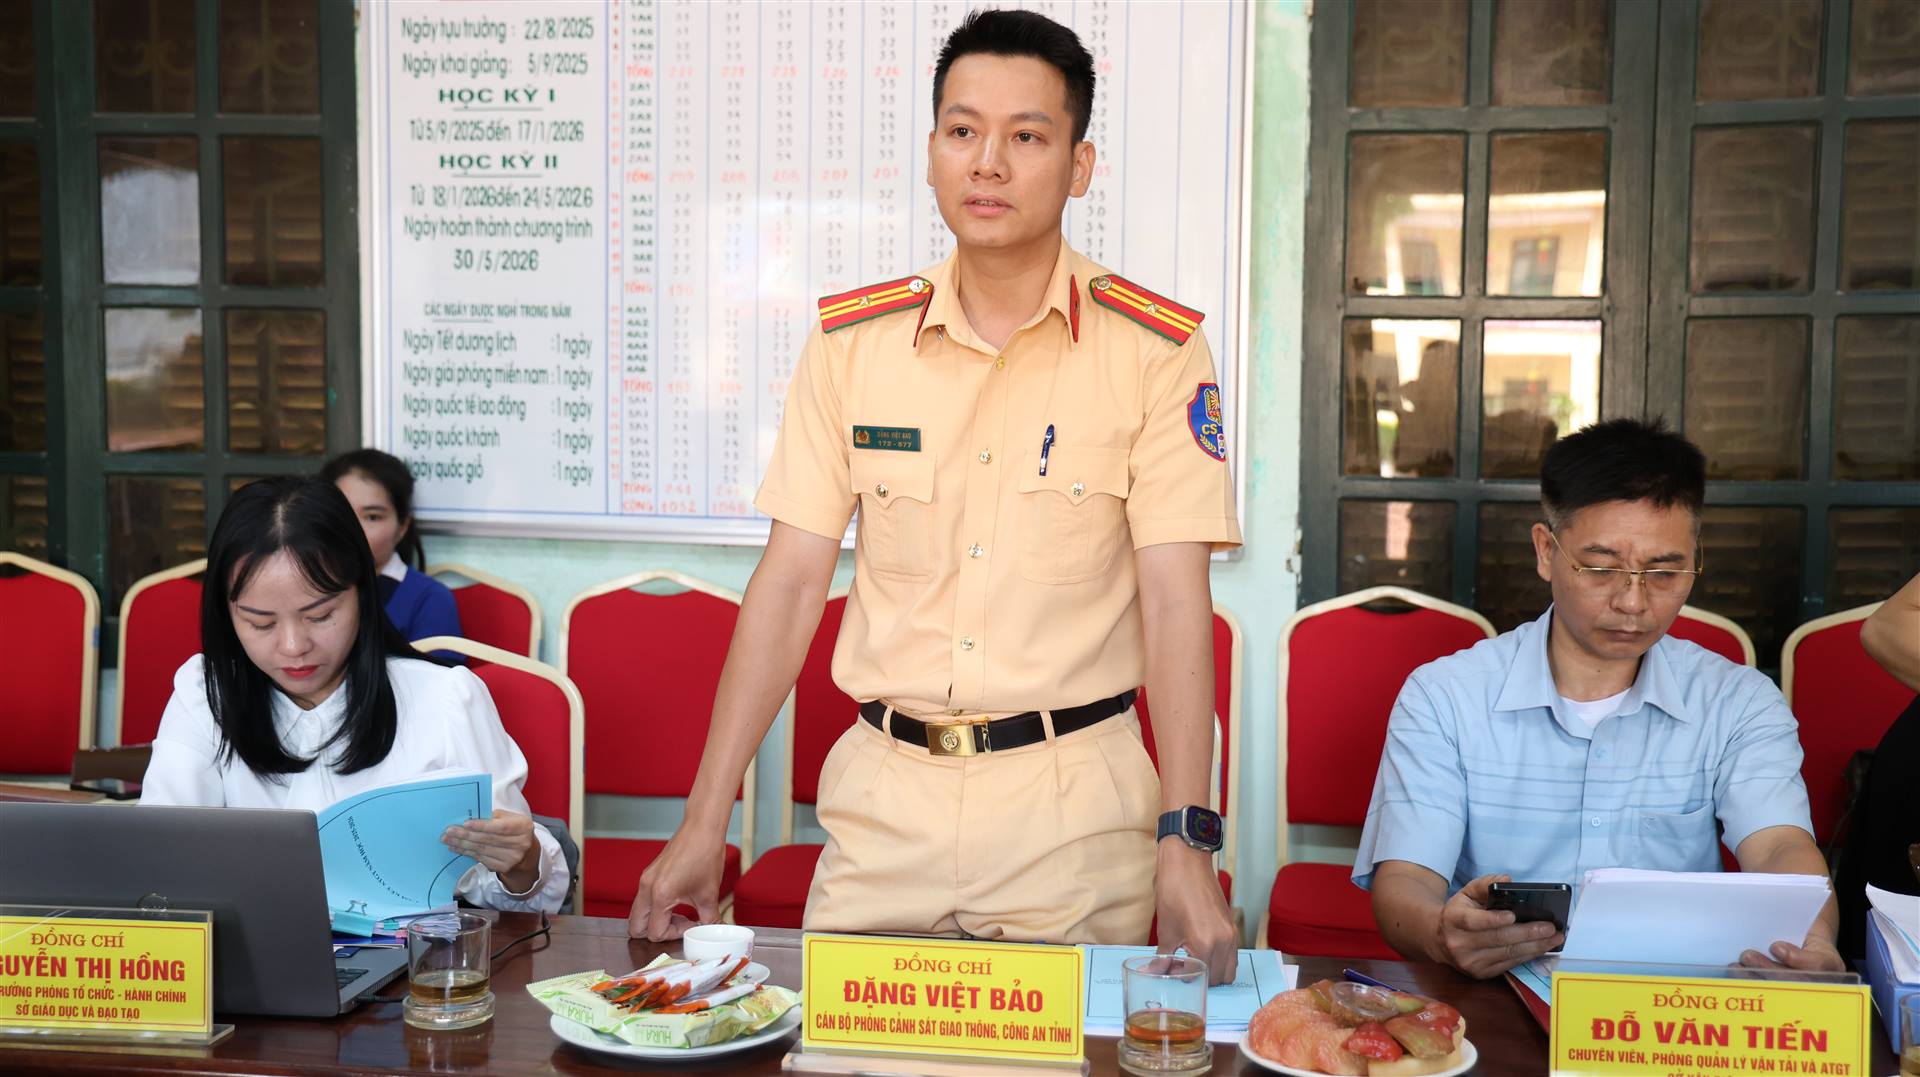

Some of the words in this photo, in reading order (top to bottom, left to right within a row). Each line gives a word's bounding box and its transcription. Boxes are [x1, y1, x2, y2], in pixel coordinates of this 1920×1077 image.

[439, 88, 494, 109] HỌC
[504, 84, 538, 103] KỲ
[549, 88, 555, 103] I
[439, 155, 491, 175] HỌC
[502, 151, 534, 169] KỲ
[545, 155, 558, 169] II
[31, 927, 86, 947] ĐỒNG
[92, 932, 125, 948] CHÍ
[0, 948, 67, 978] UYỄN
[75, 957, 111, 984] THỊ
[120, 952, 186, 981] HỒNG
[894, 952, 951, 973] ĐỒNG
[958, 958, 992, 975] CHÍ
[36, 984, 69, 999] PHÒNG
[72, 983, 85, 999] TỔ
[88, 985, 114, 1000] CHỨC
[125, 987, 152, 1002] HÀNH
[156, 988, 186, 1003] CHÍNH
[843, 976, 916, 1008] ĐẶNG
[925, 981, 981, 1013] VIỆT
[990, 978, 1043, 1013] BẢO
[1653, 986, 1719, 1009] ĐỒNG
[1725, 994, 1764, 1013] CHÍ
[16, 1000, 30, 1016] SỞ
[32, 1002, 55, 1016] GIÁO
[59, 1005, 78, 1020] DỤC
[82, 1004, 94, 1018] VÀ
[98, 1006, 117, 1021] ĐẠO
[122, 1007, 140, 1021] TẠO
[816, 1011, 836, 1029] CÁN
[839, 1014, 851, 1034] BỘ
[854, 1013, 886, 1032] PHÒNG
[890, 1012, 916, 1034] CẢNH
[919, 1015, 937, 1035] SÁT
[939, 1020, 962, 1037] GIAO
[1003, 1022, 1029, 1041] CÔNG
[1032, 1026, 1046, 1042] AN
[1050, 1021, 1072, 1043] TỈNH
[1591, 1010, 1640, 1042] ĐỖ
[1654, 1017, 1729, 1047] VĂN
[1743, 1019, 1827, 1052] TIẾN
[1568, 1047, 1614, 1062] CHUYÊN
[1618, 1048, 1648, 1066] VIÊN,
[1652, 1050, 1693, 1067] PHÒNG
[1696, 1051, 1729, 1069] QUẢN
[1733, 1055, 1747, 1070] LÝ
[1750, 1056, 1775, 1073] VẬN
[1778, 1054, 1797, 1073] TẢI
[1801, 1057, 1817, 1074] VÀ
[1820, 1063, 1850, 1076] ATGT
